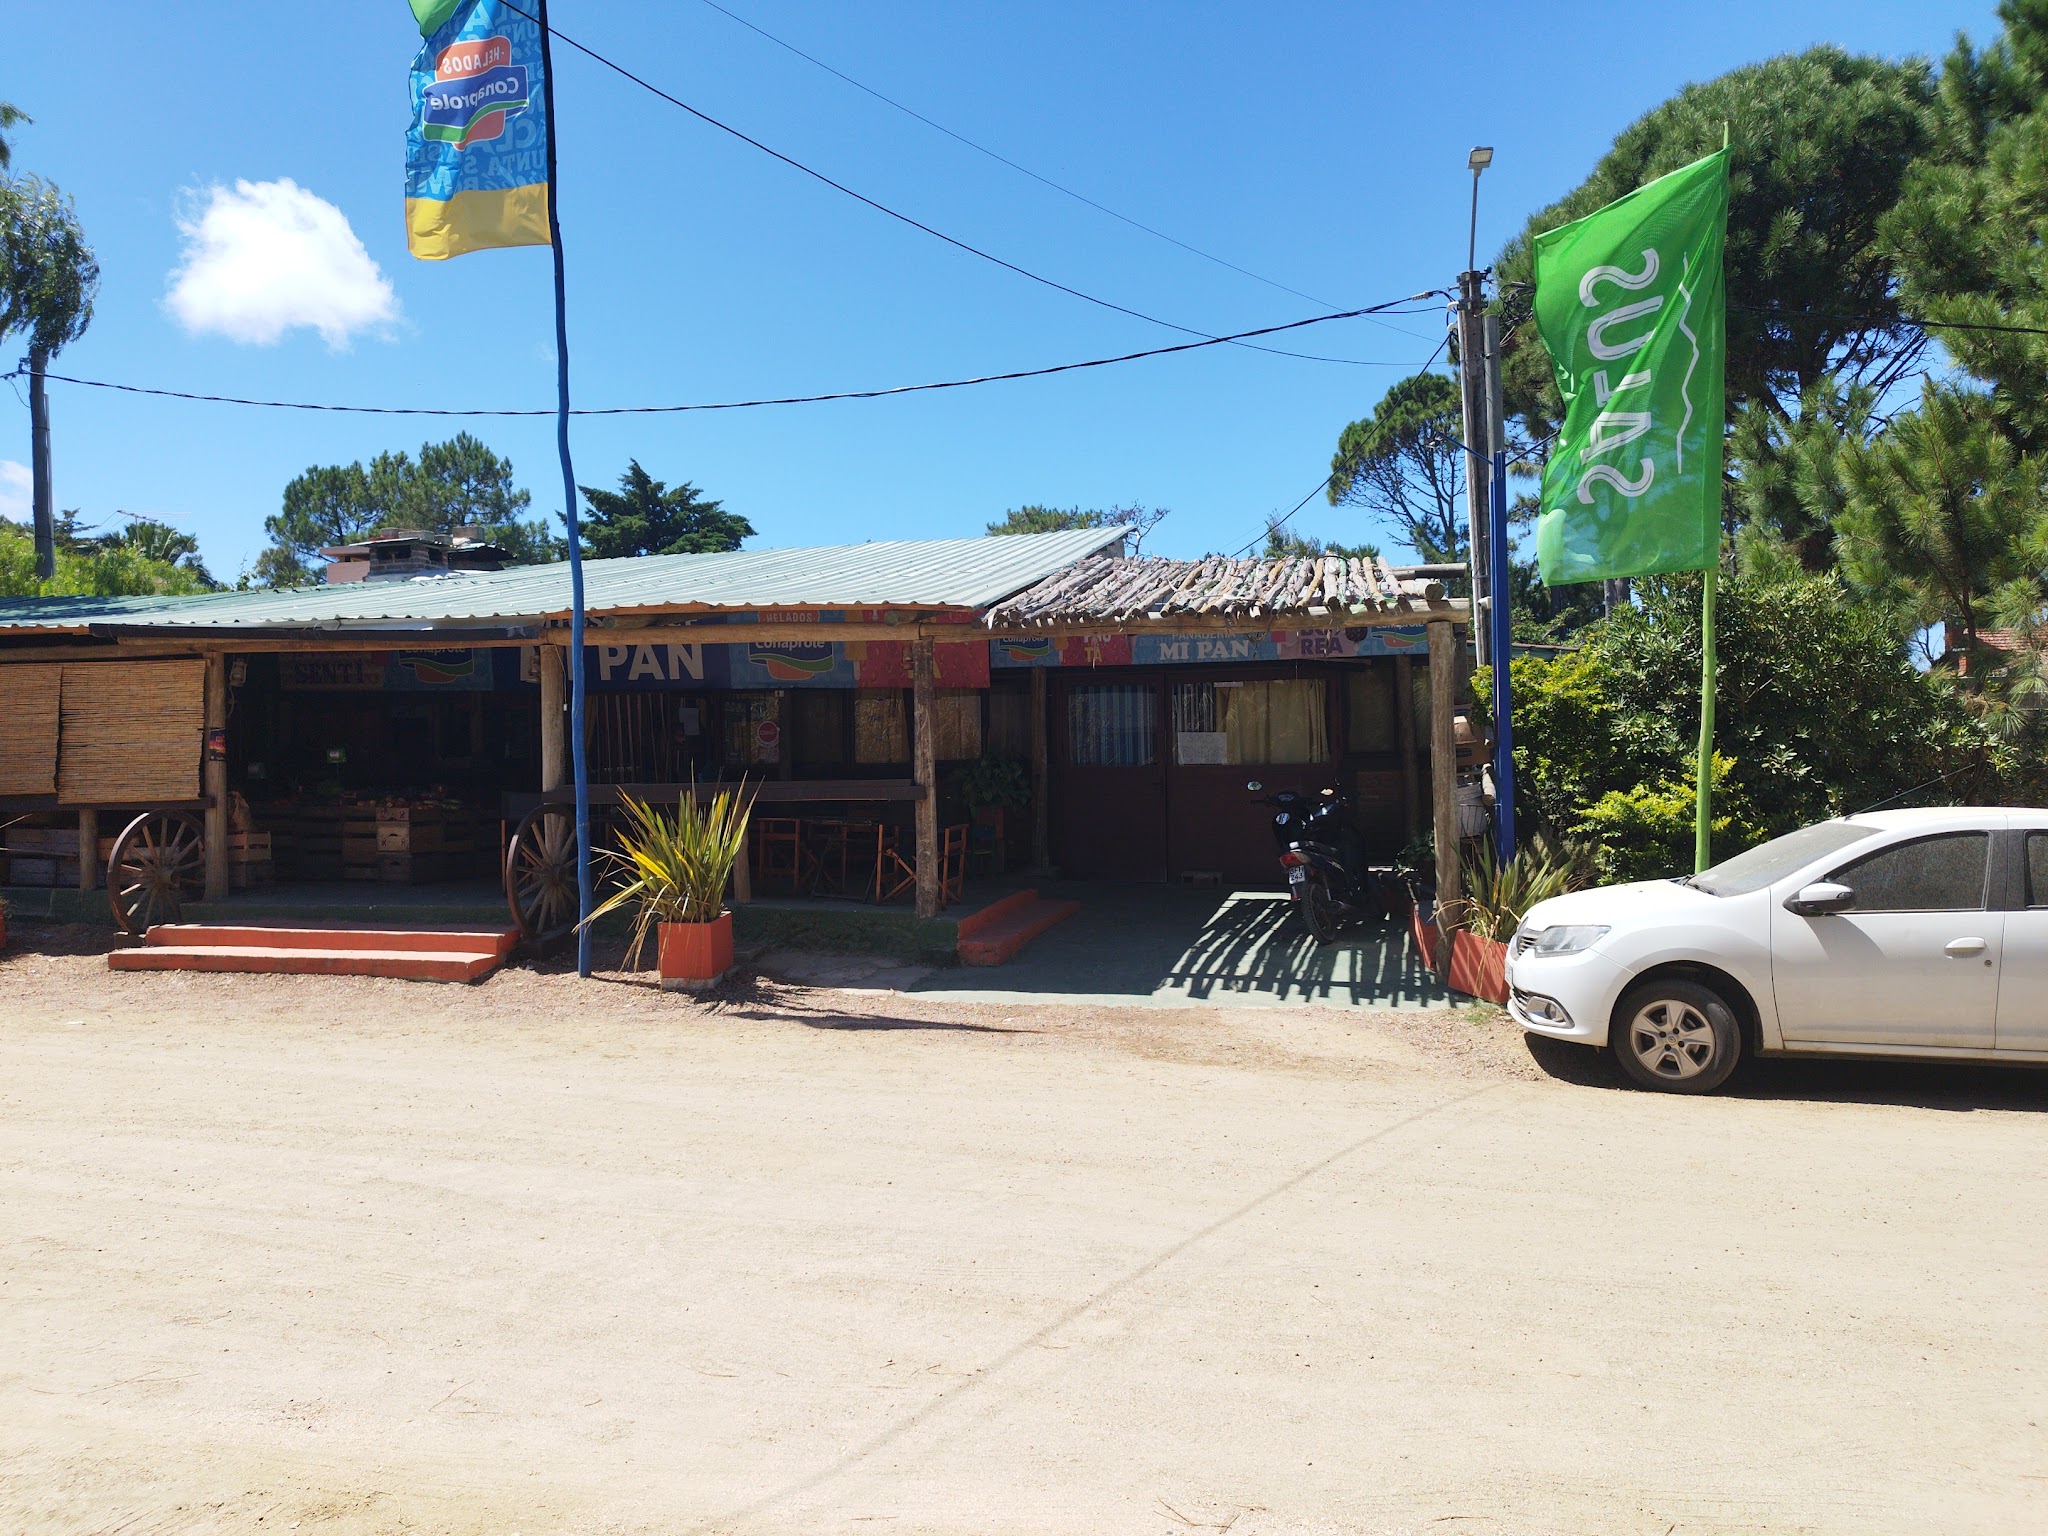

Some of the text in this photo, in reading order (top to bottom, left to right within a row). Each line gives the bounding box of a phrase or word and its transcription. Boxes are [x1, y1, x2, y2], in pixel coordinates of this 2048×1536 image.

[766, 612, 813, 624] HELADOS
[1158, 639, 1250, 661] MI PAN
[1300, 637, 1343, 655] REA
[599, 644, 704, 680] PAN
